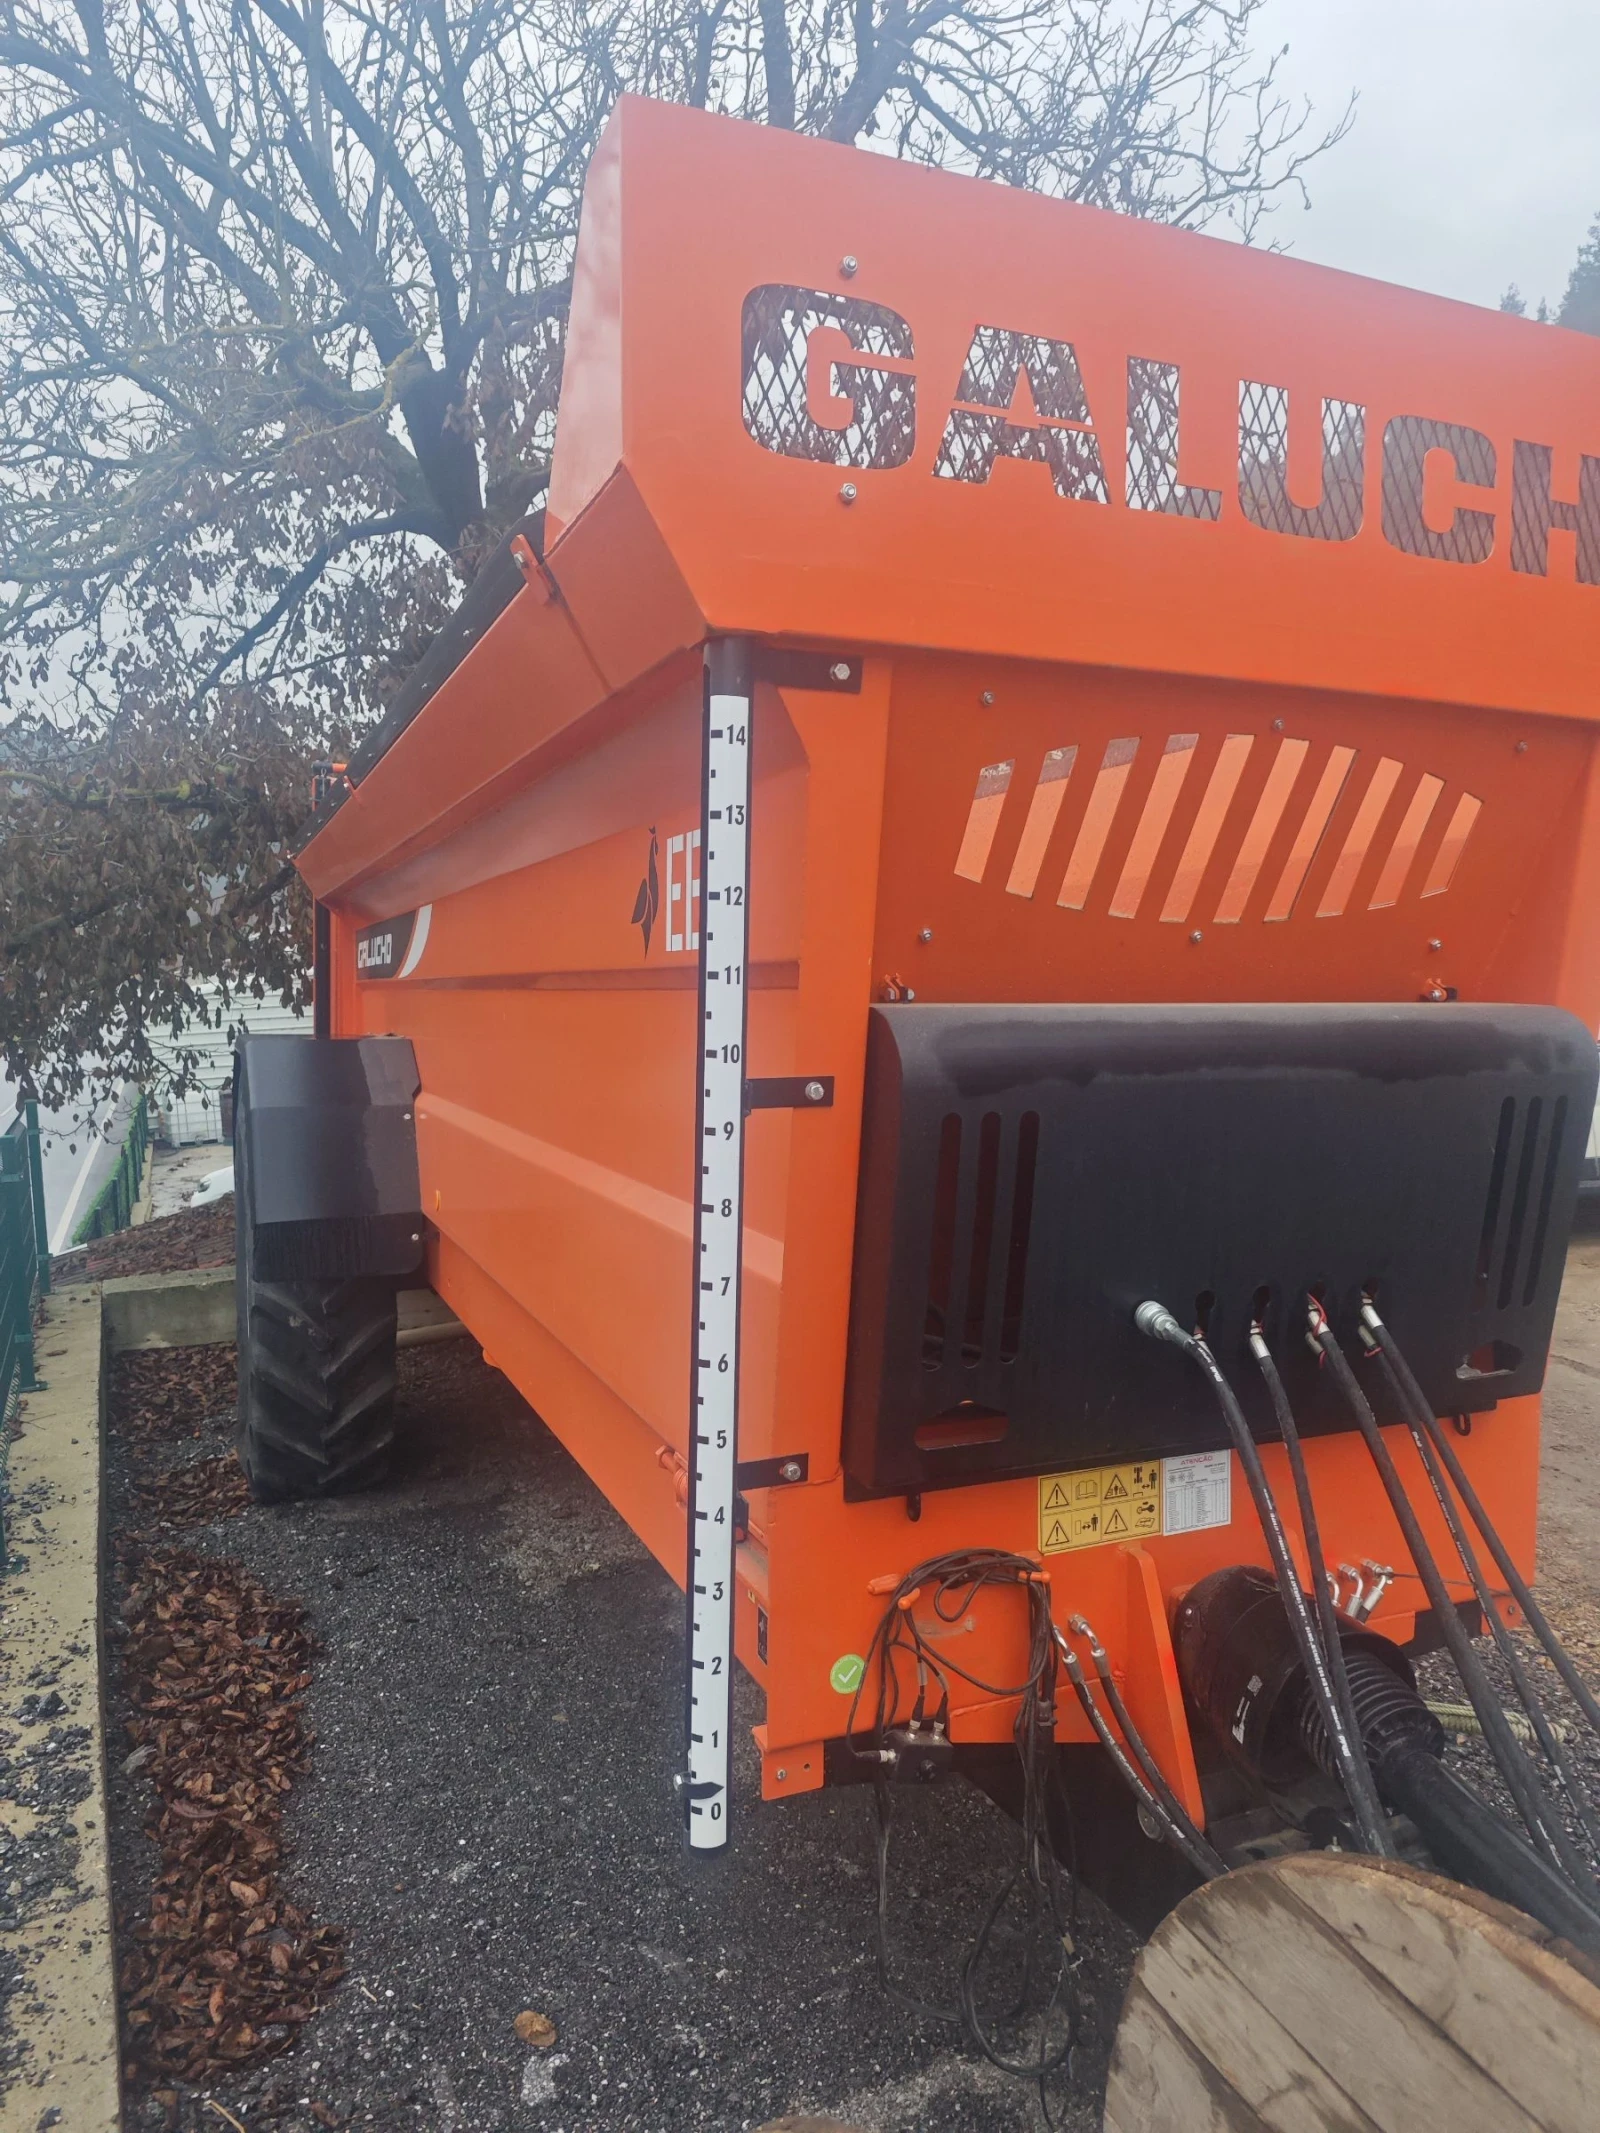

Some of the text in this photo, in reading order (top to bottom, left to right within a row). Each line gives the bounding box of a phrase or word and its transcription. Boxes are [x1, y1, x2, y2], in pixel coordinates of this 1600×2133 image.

[741, 283, 1600, 586] GALUCH
[726, 724, 746, 746] 14
[725, 804, 745, 826] 13
[723, 885, 743, 906] 12
[358, 933, 392, 969] GALUCHO
[724, 964, 742, 986] 11
[721, 1043, 741, 1065] 10
[723, 1120, 735, 1141] 9
[720, 1198, 733, 1218] 8
[720, 1276, 731, 1297] 7
[717, 1353, 729, 1373] 6
[716, 1429, 727, 1449] 5
[713, 1505, 725, 1525] 4
[712, 1581, 724, 1601] 3
[711, 1656, 722, 1676] 2
[711, 1729, 718, 1749] 1
[710, 1802, 722, 1821] 0
